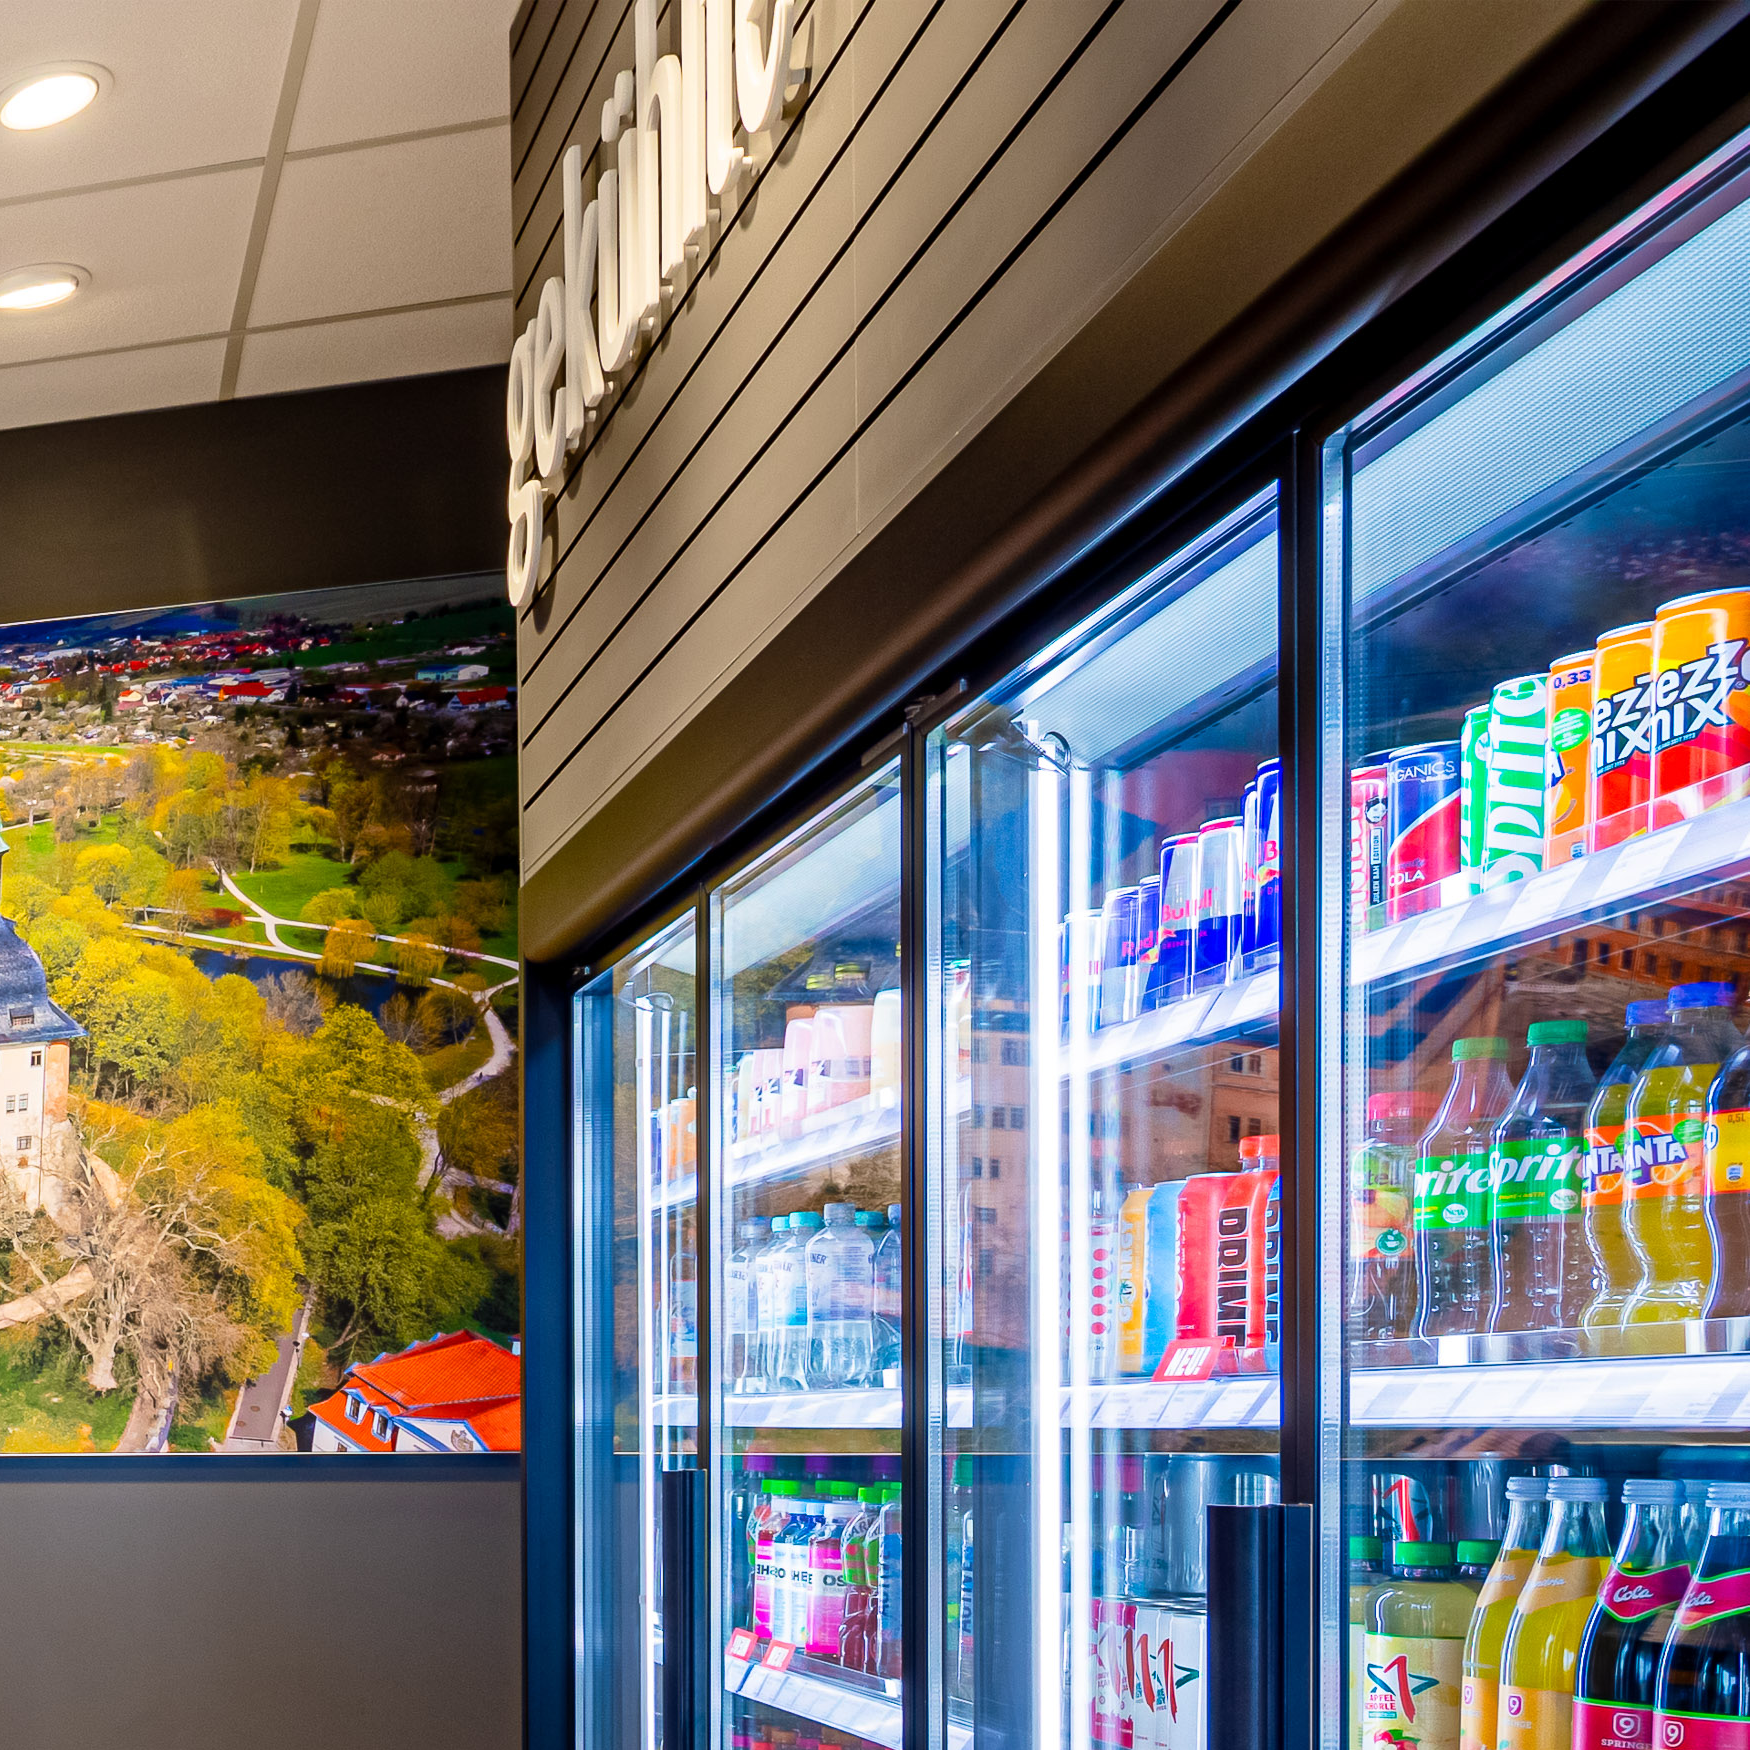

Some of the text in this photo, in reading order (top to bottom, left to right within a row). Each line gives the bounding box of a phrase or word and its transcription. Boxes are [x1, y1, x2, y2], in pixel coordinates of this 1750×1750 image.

[1553, 670, 1591, 689] 0,33
[1389, 870, 1425, 886] COLA
[1445, 1207, 1467, 1218] New
[1164, 1346, 1212, 1376] NEU!
[1613, 1585, 1653, 1602] Cola
[1369, 1694, 1395, 1702] APFEL
[1601, 1738, 1652, 1750] SPRINGE
